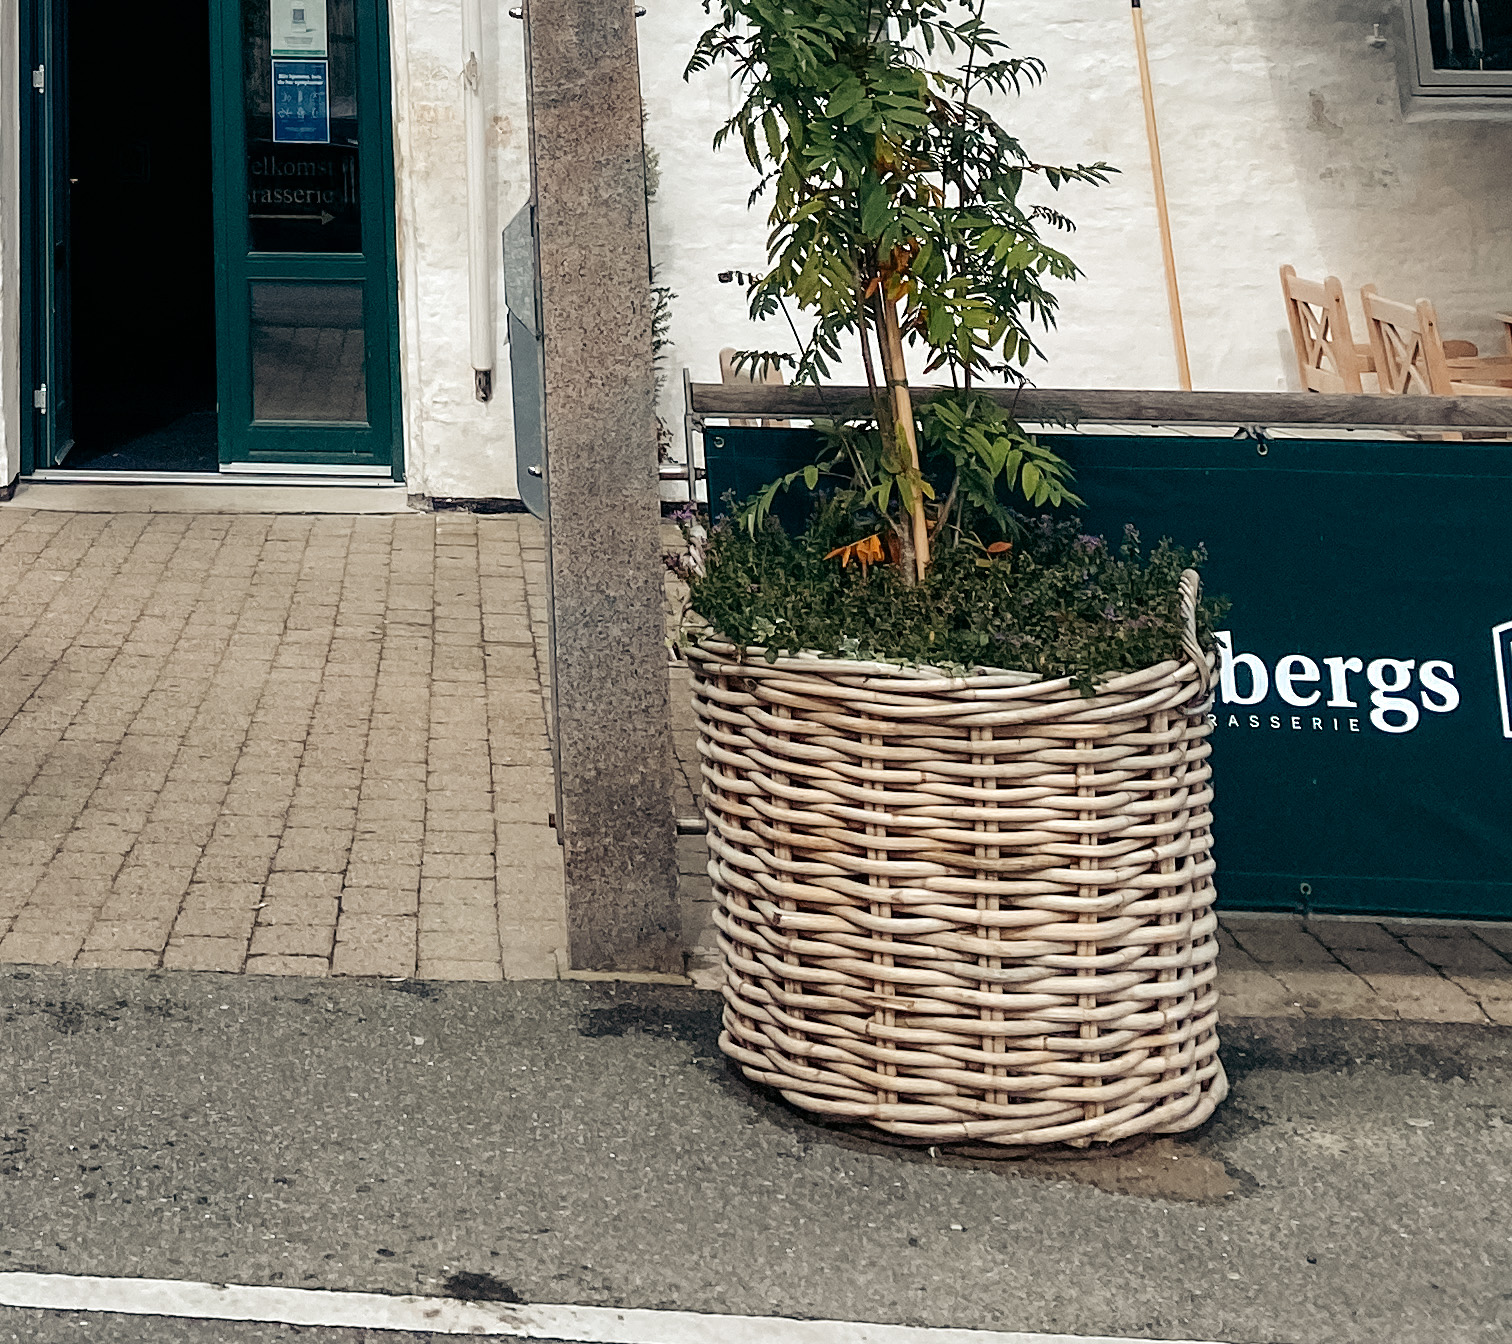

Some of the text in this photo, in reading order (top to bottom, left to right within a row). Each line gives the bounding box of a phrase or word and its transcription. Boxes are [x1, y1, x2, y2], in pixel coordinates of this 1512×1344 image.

[248, 188, 334, 204] rasserie
[1210, 630, 1461, 733] bergs
[1206, 713, 1361, 732] RASSERIE
